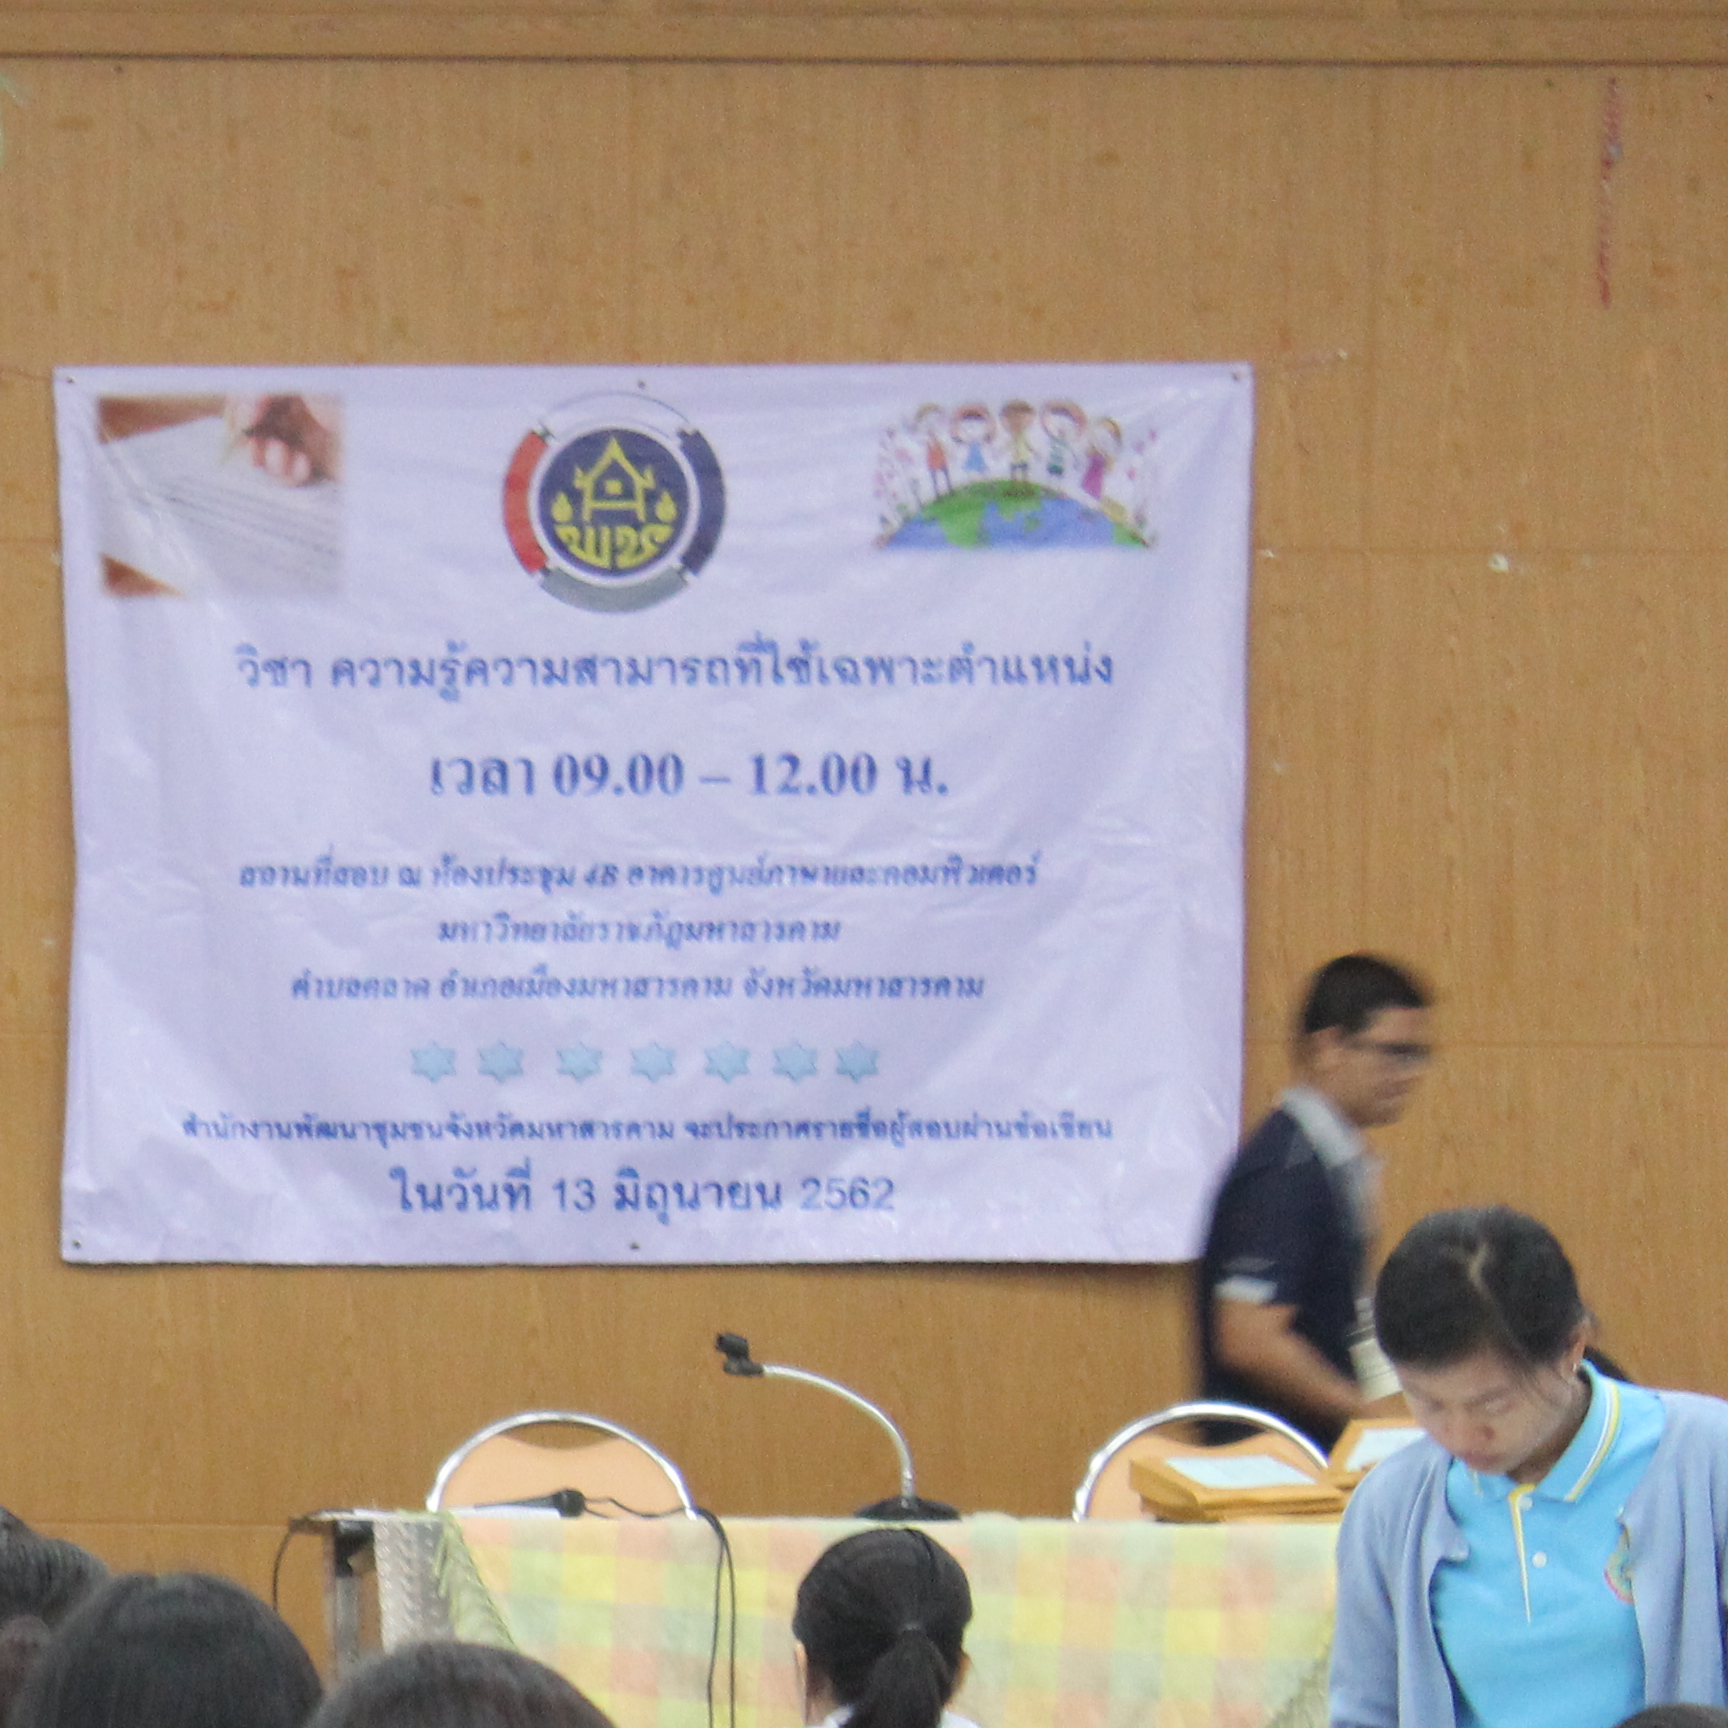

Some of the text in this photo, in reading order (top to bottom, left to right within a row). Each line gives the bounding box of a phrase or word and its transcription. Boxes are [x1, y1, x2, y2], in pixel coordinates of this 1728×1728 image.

[234, 631, 1114, 702] วิชา ความรู้ความสามารถที่ใช้เฉพาะตำแหน่ง
[429, 756, 536, 797] เวลา
[551, 750, 686, 798] 09.00
[749, 750, 880, 798] 12.00
[893, 755, 950, 797] น.
[238, 844, 391, 889] สถานที่สอบ
[432, 851, 577, 896] ห้องประชุม
[743, 965, 987, 1000] จังหวัดมหาสารคาม
[181, 1110, 676, 1150] สำนักงานพัฒนาชุมชนจังหวัดมหาสารคาม
[386, 1155, 899, 1227] ในวันที่ 13 มิถุนายน 2562
